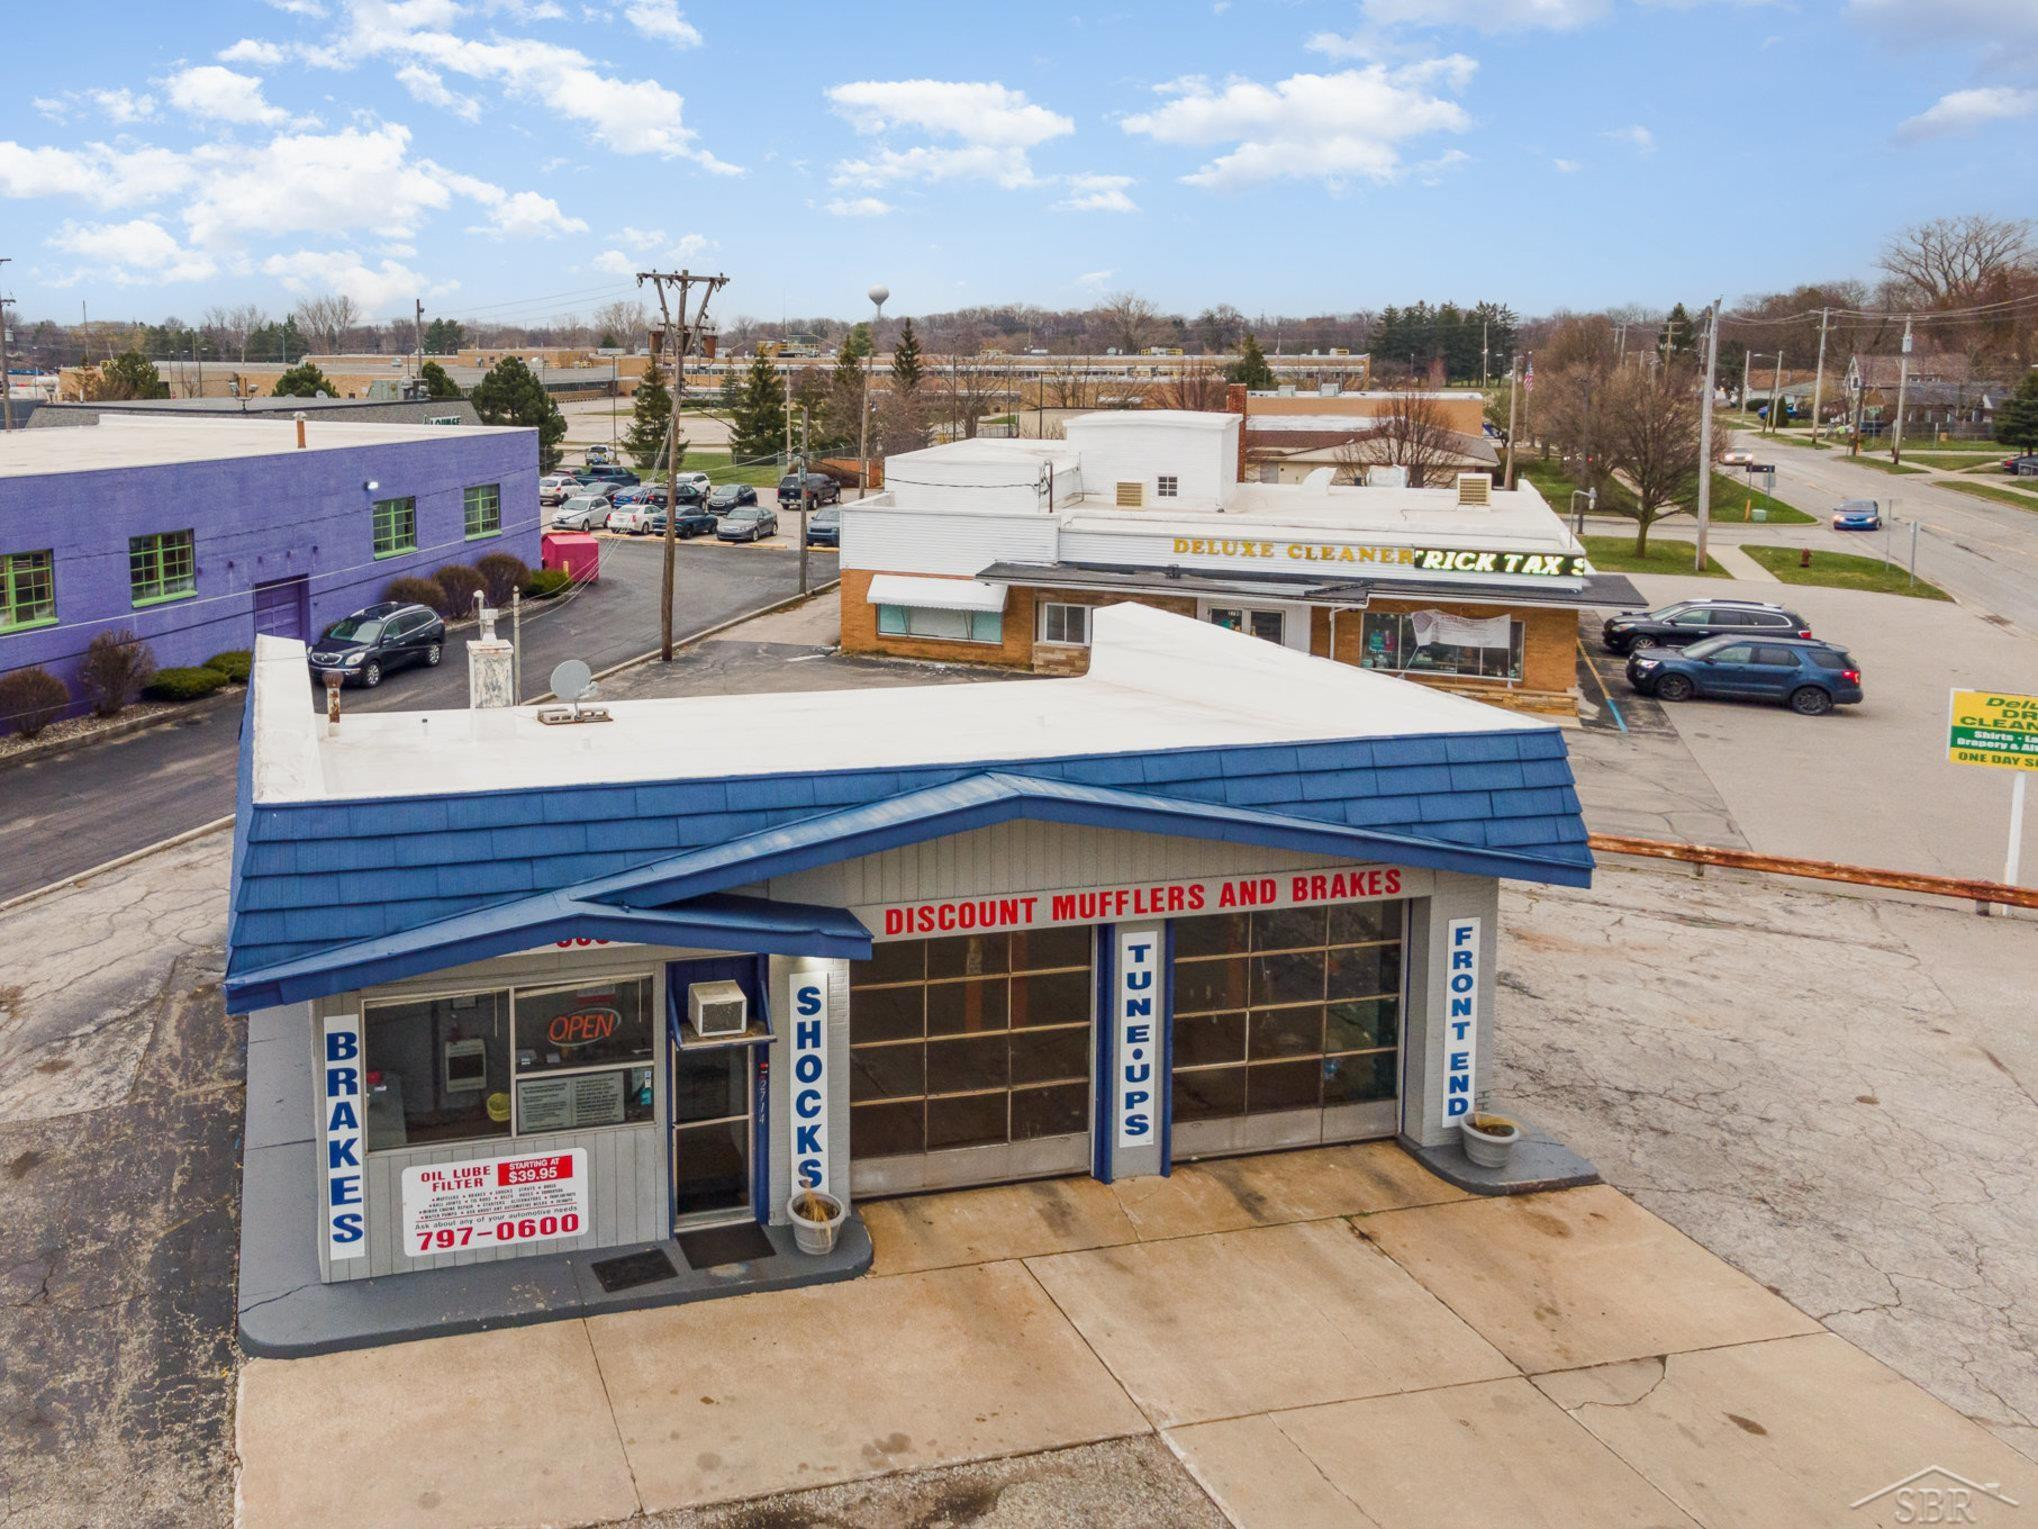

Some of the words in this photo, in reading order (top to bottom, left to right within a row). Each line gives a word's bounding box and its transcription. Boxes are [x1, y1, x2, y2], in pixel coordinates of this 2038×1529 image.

[1173, 537, 1274, 558] DELUXE
[1287, 543, 1415, 565] CLEANER
[1415, 550, 1497, 572] RICK
[1504, 553, 1564, 576] TAX
[1958, 751, 1988, 763] ONE
[1991, 754, 2021, 766] DAY
[885, 897, 1038, 935] DISCOUNT
[1052, 884, 1205, 921] MUFFLERS
[1218, 878, 1277, 908] AND
[1292, 868, 1401, 903] BRAKES
[1451, 926, 1474, 1041] FRONT
[548, 1012, 614, 1041] OPEN
[795, 985, 823, 1189] SHOCKS
[1448, 1051, 1470, 1116] END
[326, 1031, 364, 1243] BRAKES
[420, 1170, 445, 1183] OIL
[453, 1165, 491, 1179] LUBE
[508, 1166, 558, 1184] $39.95
[509, 1158, 548, 1170] STARTING
[550, 1157, 560, 1166] AT
[432, 1178, 484, 1192] FILTER
[415, 1223, 429, 1231] Ask
[433, 1220, 456, 1228] about
[488, 1214, 505, 1223] your
[508, 1208, 551, 1219] automotive
[554, 1205, 578, 1213] needs
[416, 1213, 579, 1251] 797-0600
